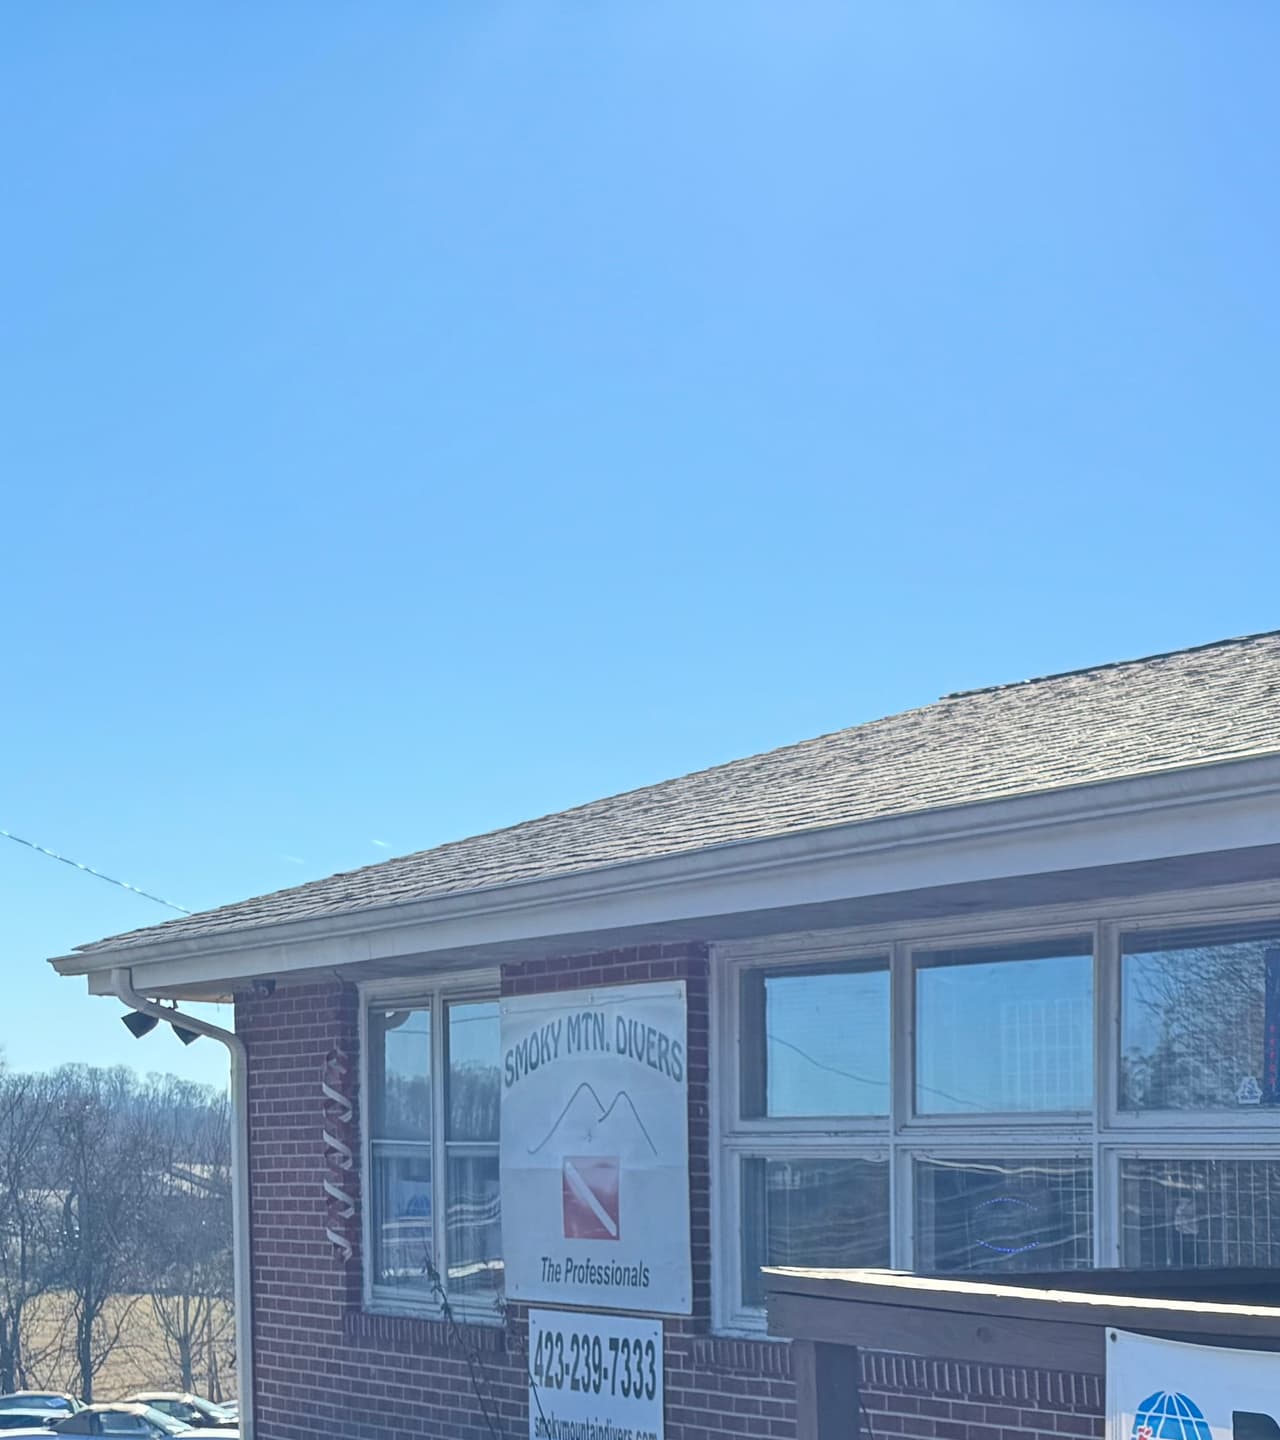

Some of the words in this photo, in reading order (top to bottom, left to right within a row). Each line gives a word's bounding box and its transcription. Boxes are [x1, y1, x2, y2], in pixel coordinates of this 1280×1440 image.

[505, 1019, 562, 1088] SMOKY
[567, 1012, 610, 1054] MTN.
[616, 1015, 683, 1083] DIVERS
[541, 1257, 561, 1283] The
[564, 1257, 650, 1288] Professionals
[533, 1329, 657, 1401] 423-239-7333
